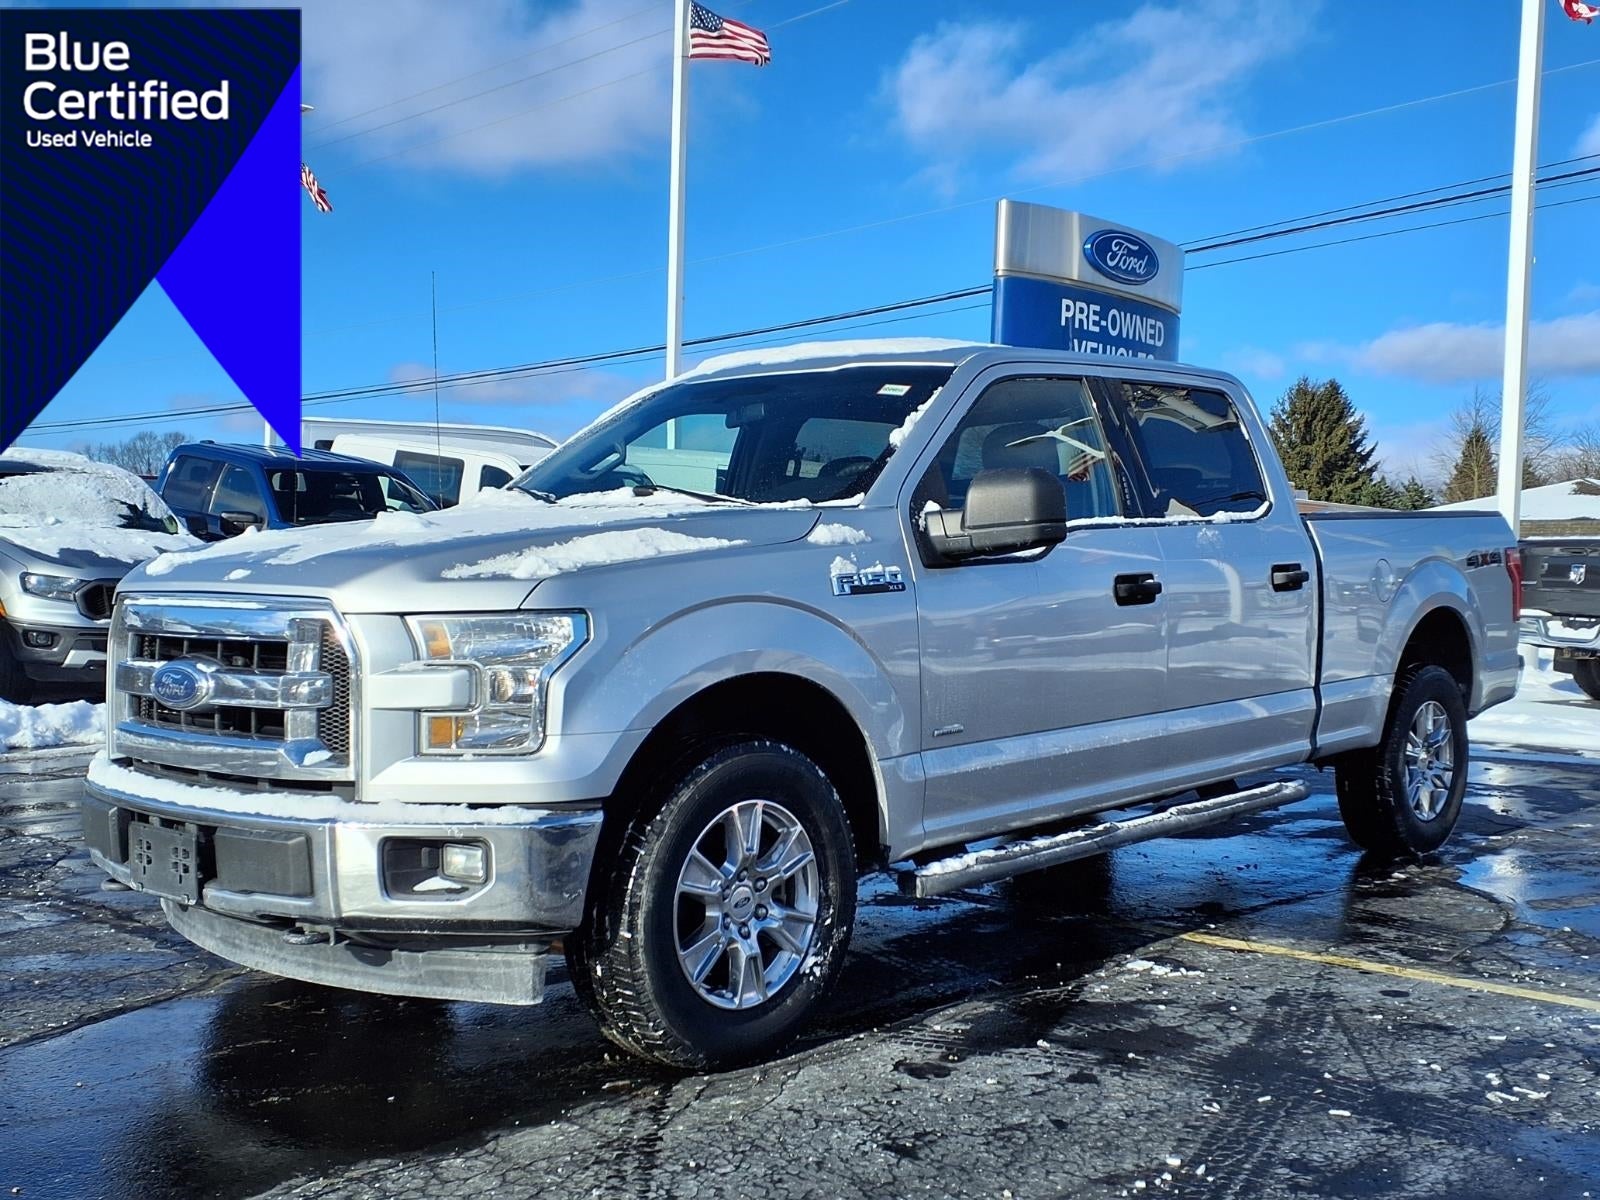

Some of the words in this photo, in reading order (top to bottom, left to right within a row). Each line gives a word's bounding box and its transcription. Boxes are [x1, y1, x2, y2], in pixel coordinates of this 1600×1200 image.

[1106, 238, 1149, 275] Ford
[1060, 298, 1165, 348] PRE-OWNED
[158, 672, 188, 697] Ford
